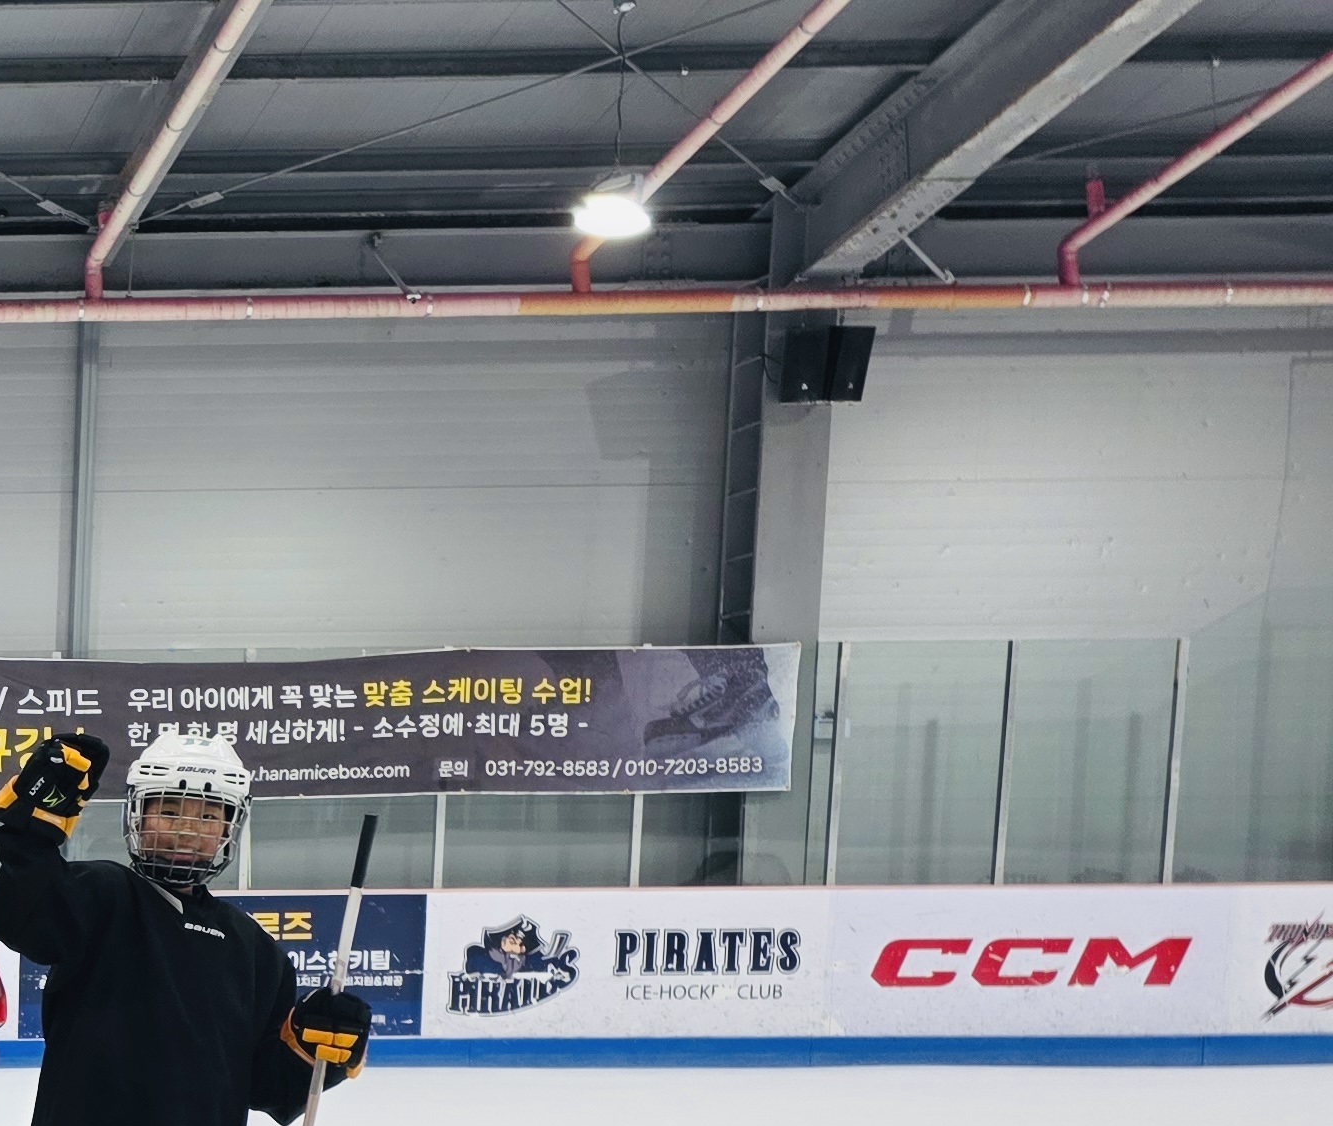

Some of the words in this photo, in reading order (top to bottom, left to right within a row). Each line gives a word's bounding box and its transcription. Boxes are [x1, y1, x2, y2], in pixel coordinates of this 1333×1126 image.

[16, 686, 103, 716] 스피드
[127, 687, 172, 713] 우리
[180, 685, 273, 712] 아이에게
[280, 686, 304, 709] 꼭
[310, 683, 358, 709] 맞는
[363, 680, 414, 709] 맞춤
[421, 677, 523, 706] 스케이팅
[531, 677, 592, 704] 수업!
[127, 722, 151, 747] 한
[218, 720, 241, 746] 명
[245, 717, 347, 746] 세심하게!
[529, 711, 572, 737] 5명
[177, 765, 217, 776] BAUER
[250, 762, 411, 783] .hanamicebox.com
[438, 760, 470, 778] 문의
[184, 922, 226, 940] BAUER
[612, 928, 803, 978] PIRATES
[870, 937, 1193, 988] CCM
[736, 983, 784, 1000] CLUB
